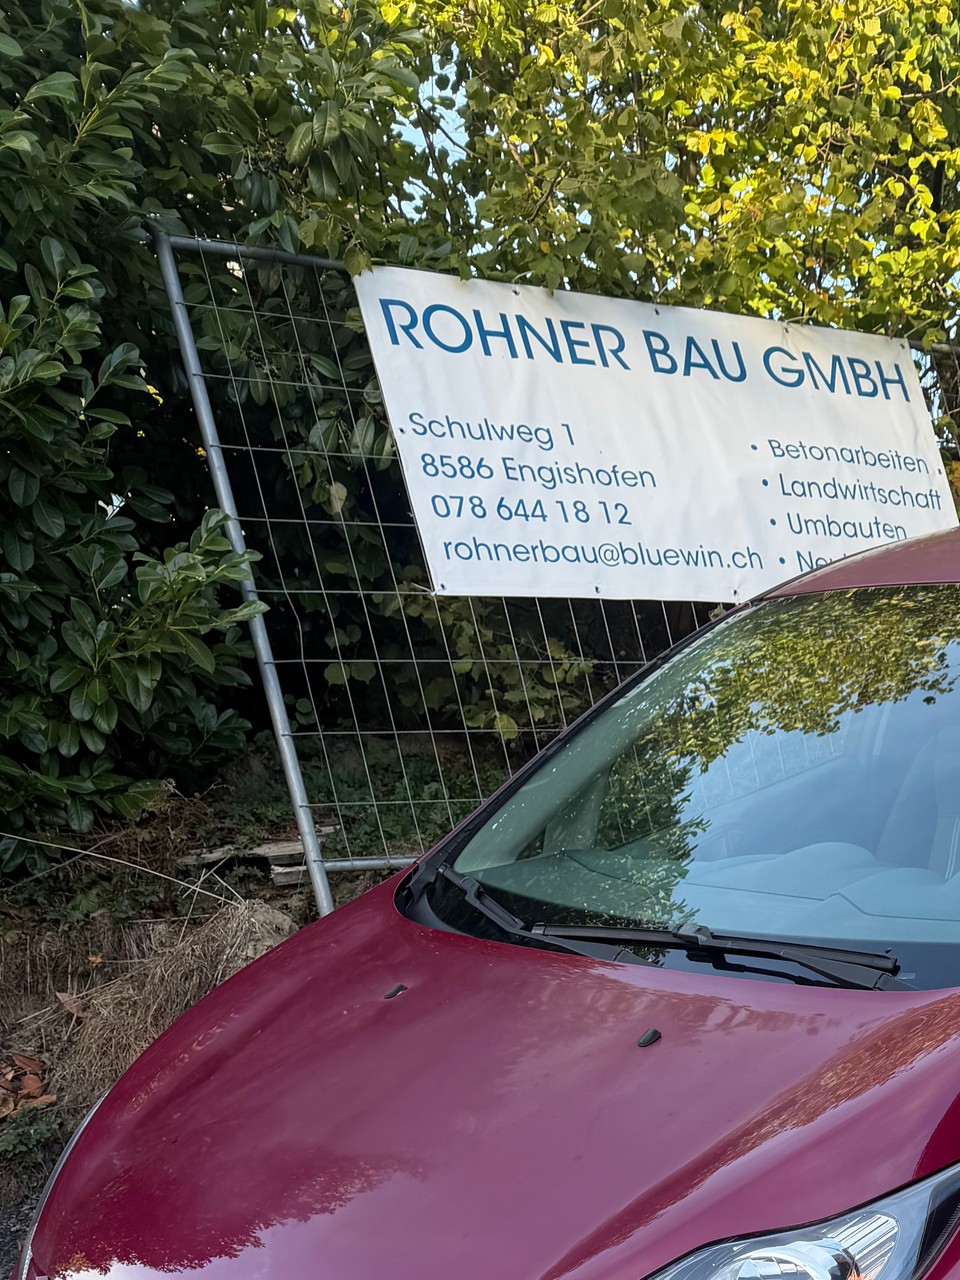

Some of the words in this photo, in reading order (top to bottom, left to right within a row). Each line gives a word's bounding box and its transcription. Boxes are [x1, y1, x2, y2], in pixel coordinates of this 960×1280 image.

[379, 298, 631, 371] ROHNER
[642, 330, 747, 382] BAU
[763, 346, 911, 402] GMBH
[408, 412, 554, 450] Schulweg
[561, 423, 575, 446] 1
[420, 453, 495, 480] 8586
[502, 457, 657, 489] Engishofen
[768, 439, 930, 475] Betonarbeiten
[779, 473, 942, 510] Landwirtschaft
[431, 495, 487, 519] 078
[496, 497, 548, 522] 644
[556, 500, 591, 523] 18
[599, 501, 632, 525] 12
[787, 512, 908, 541] Umbauten
[443, 537, 764, 570] rohnerbau@bluewin.ch
